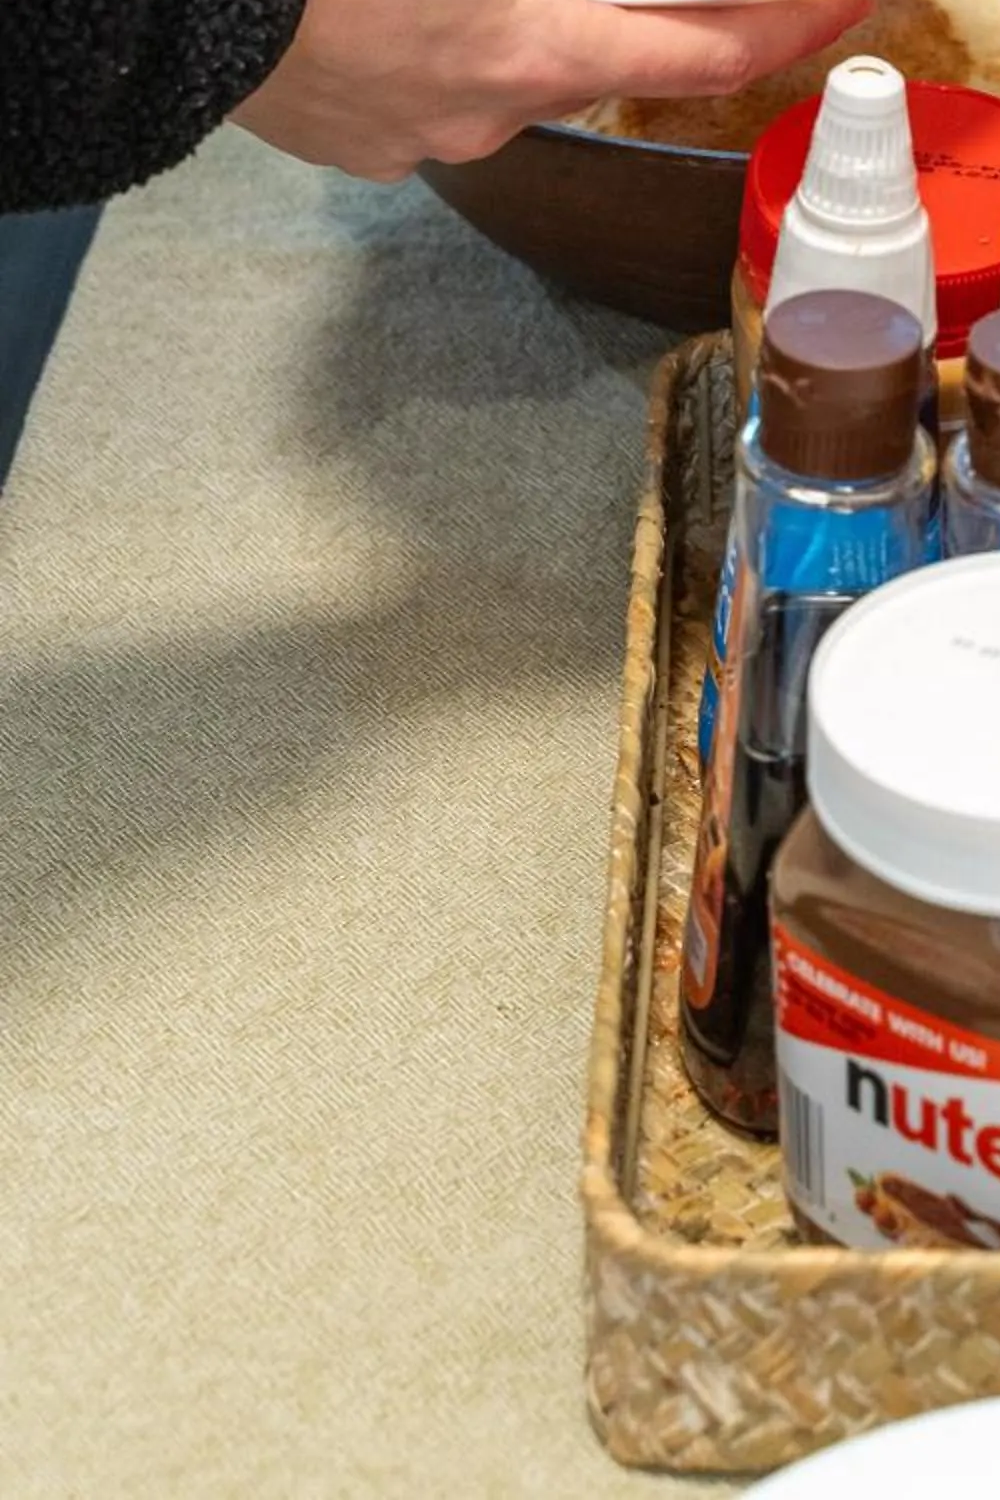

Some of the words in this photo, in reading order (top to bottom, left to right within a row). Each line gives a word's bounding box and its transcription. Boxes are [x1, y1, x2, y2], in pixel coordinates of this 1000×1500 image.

[786, 951, 882, 1025] CELEBRATE
[887, 1010, 944, 1052] WITH
[948, 1039, 988, 1072] US!
